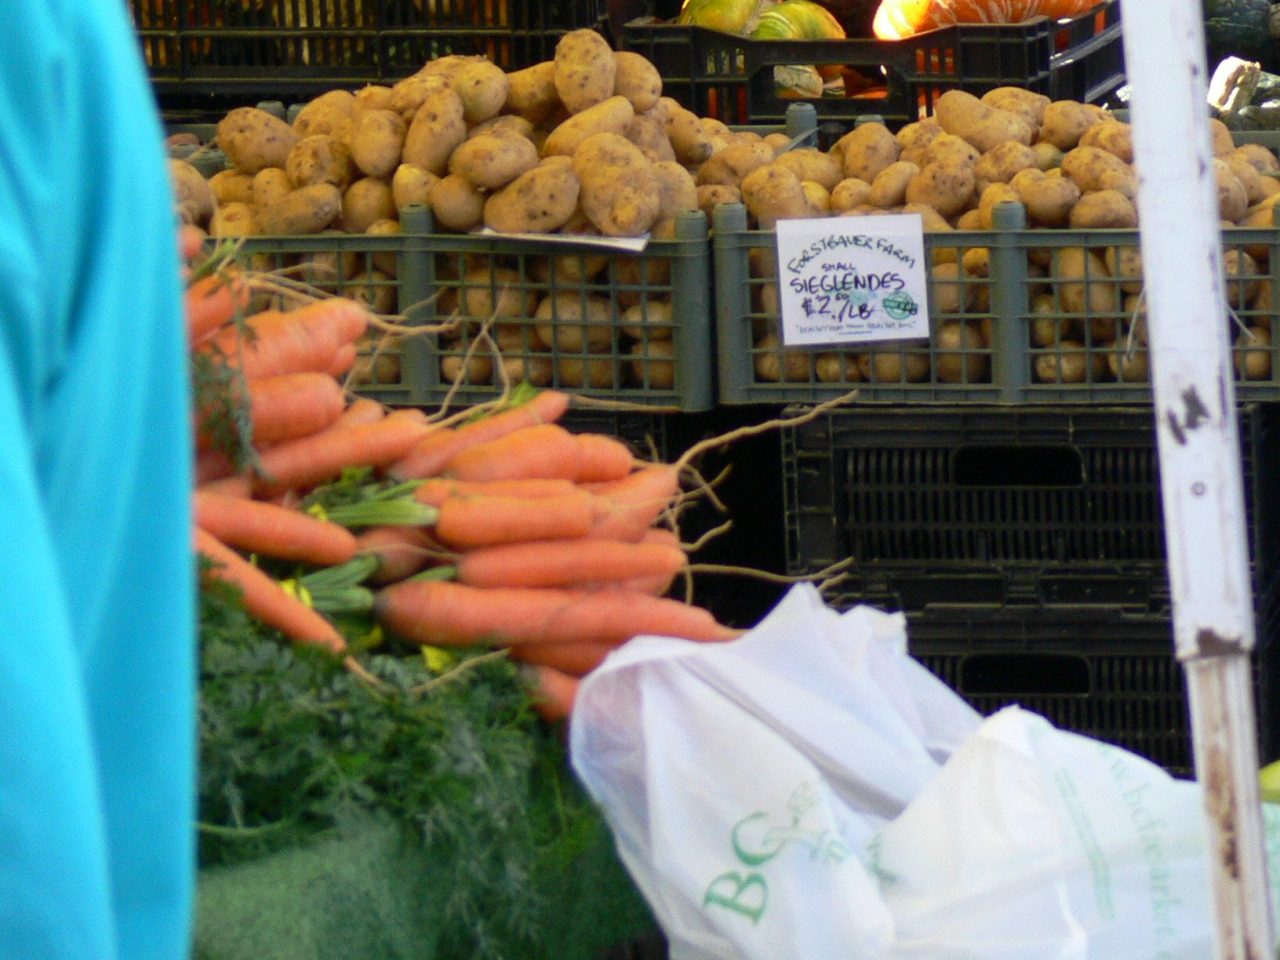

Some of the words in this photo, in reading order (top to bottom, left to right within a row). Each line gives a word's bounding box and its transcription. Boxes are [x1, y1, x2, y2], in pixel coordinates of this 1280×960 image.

[876, 238, 915, 269] FARM
[821, 262, 856, 271] SMALL
[790, 272, 905, 294] SIEGLENDES
